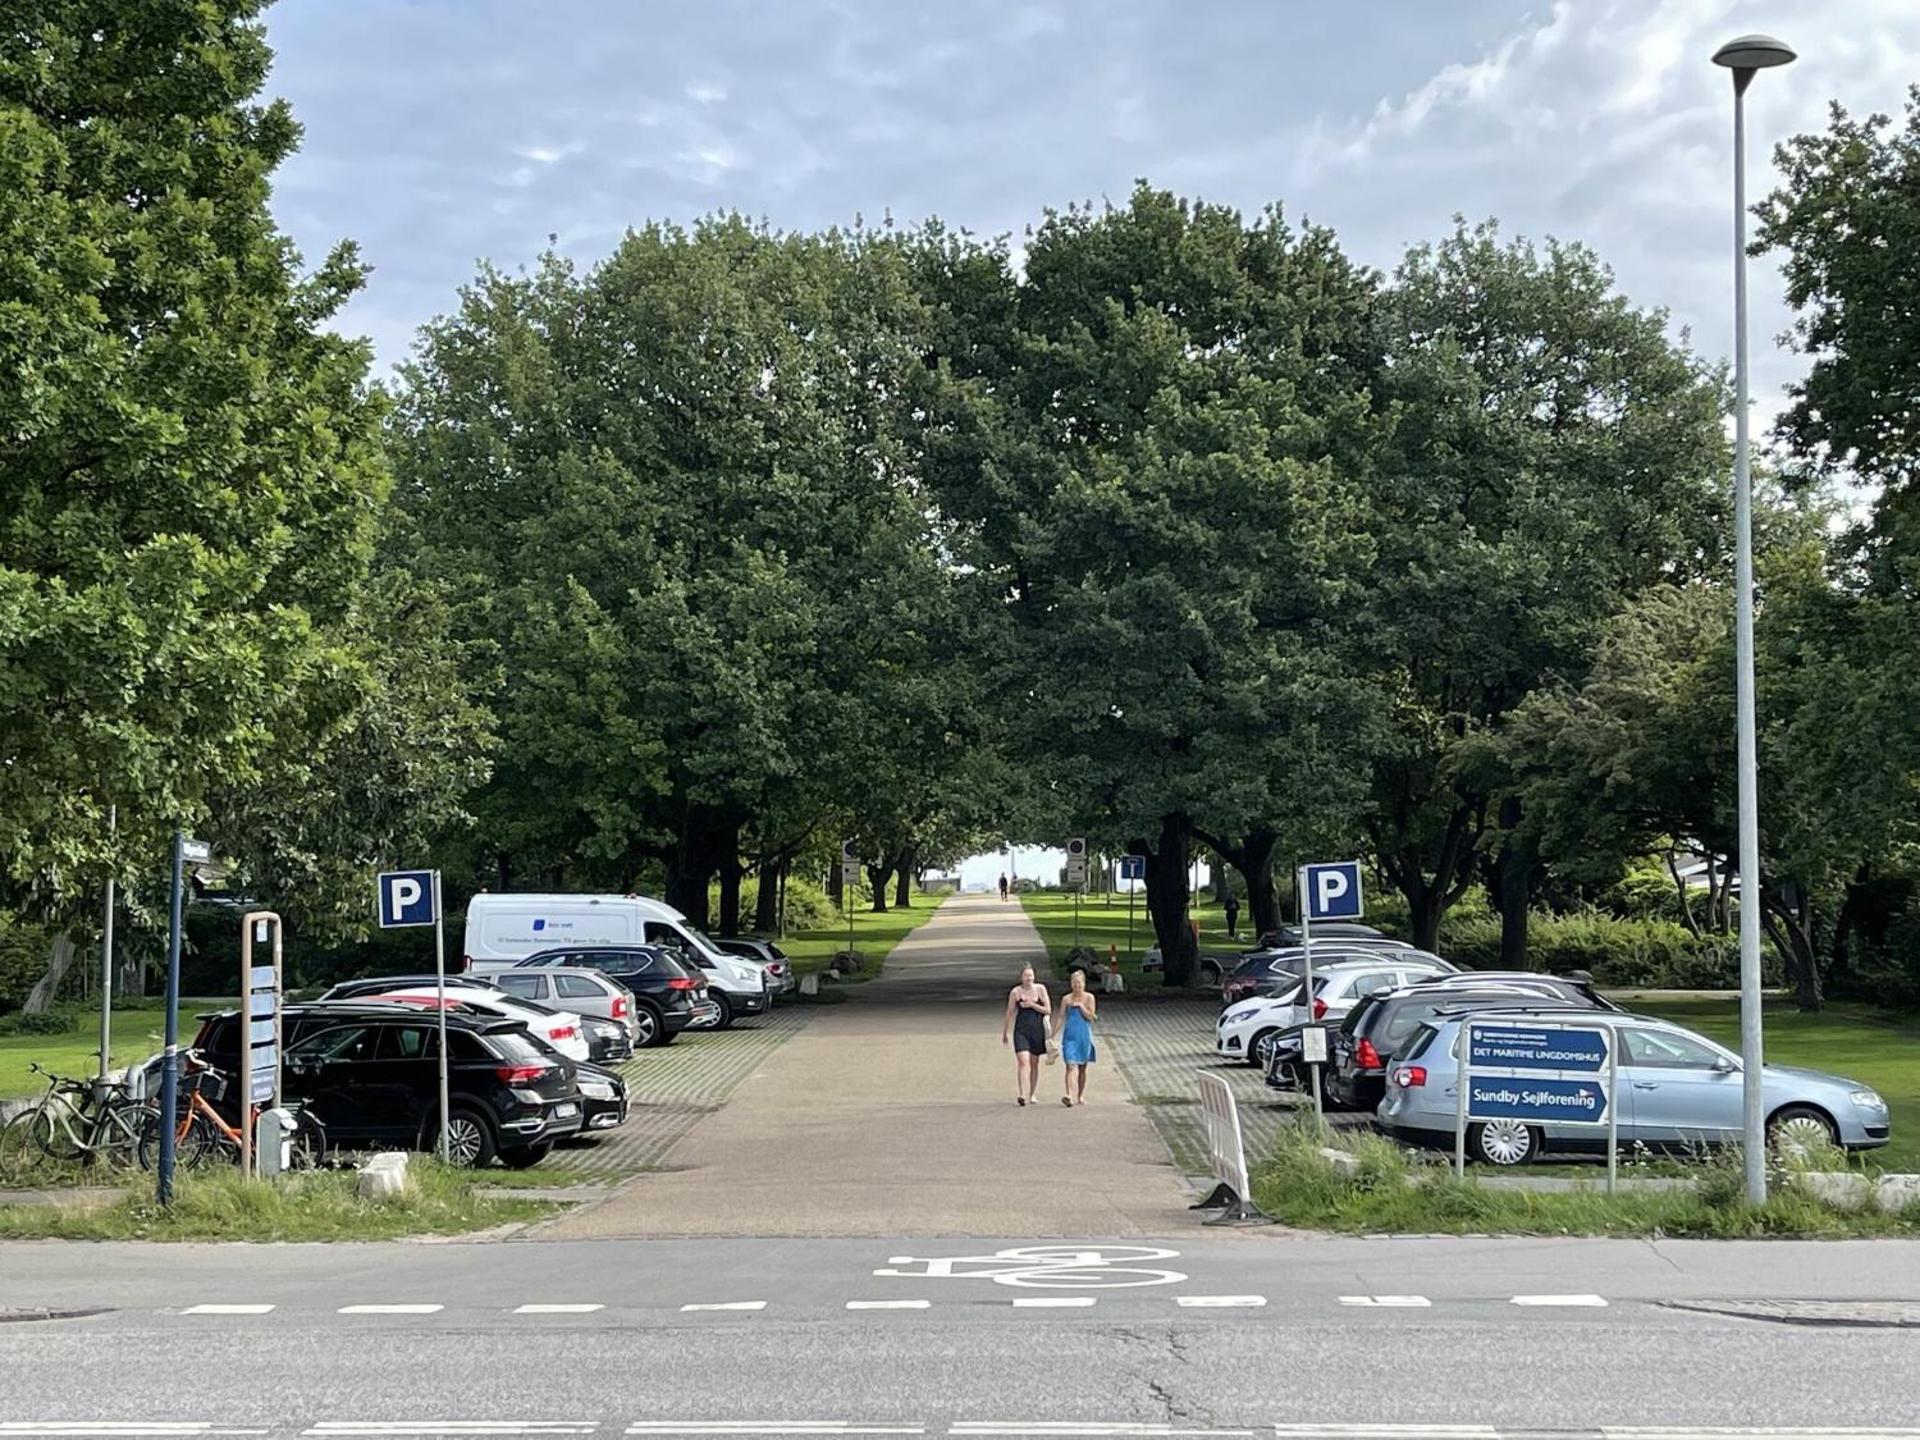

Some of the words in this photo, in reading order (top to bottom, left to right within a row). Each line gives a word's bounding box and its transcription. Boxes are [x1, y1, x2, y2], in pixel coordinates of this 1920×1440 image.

[392, 878, 421, 920] P
[1318, 871, 1348, 912] P
[1474, 1047, 1491, 1057] DET
[1493, 1048, 1534, 1059] MARITIME
[1536, 1050, 1600, 1062] UNGDOMSHUS
[1474, 1089, 1520, 1106] Sundby
[1522, 1091, 1595, 1110] Sejlforening
